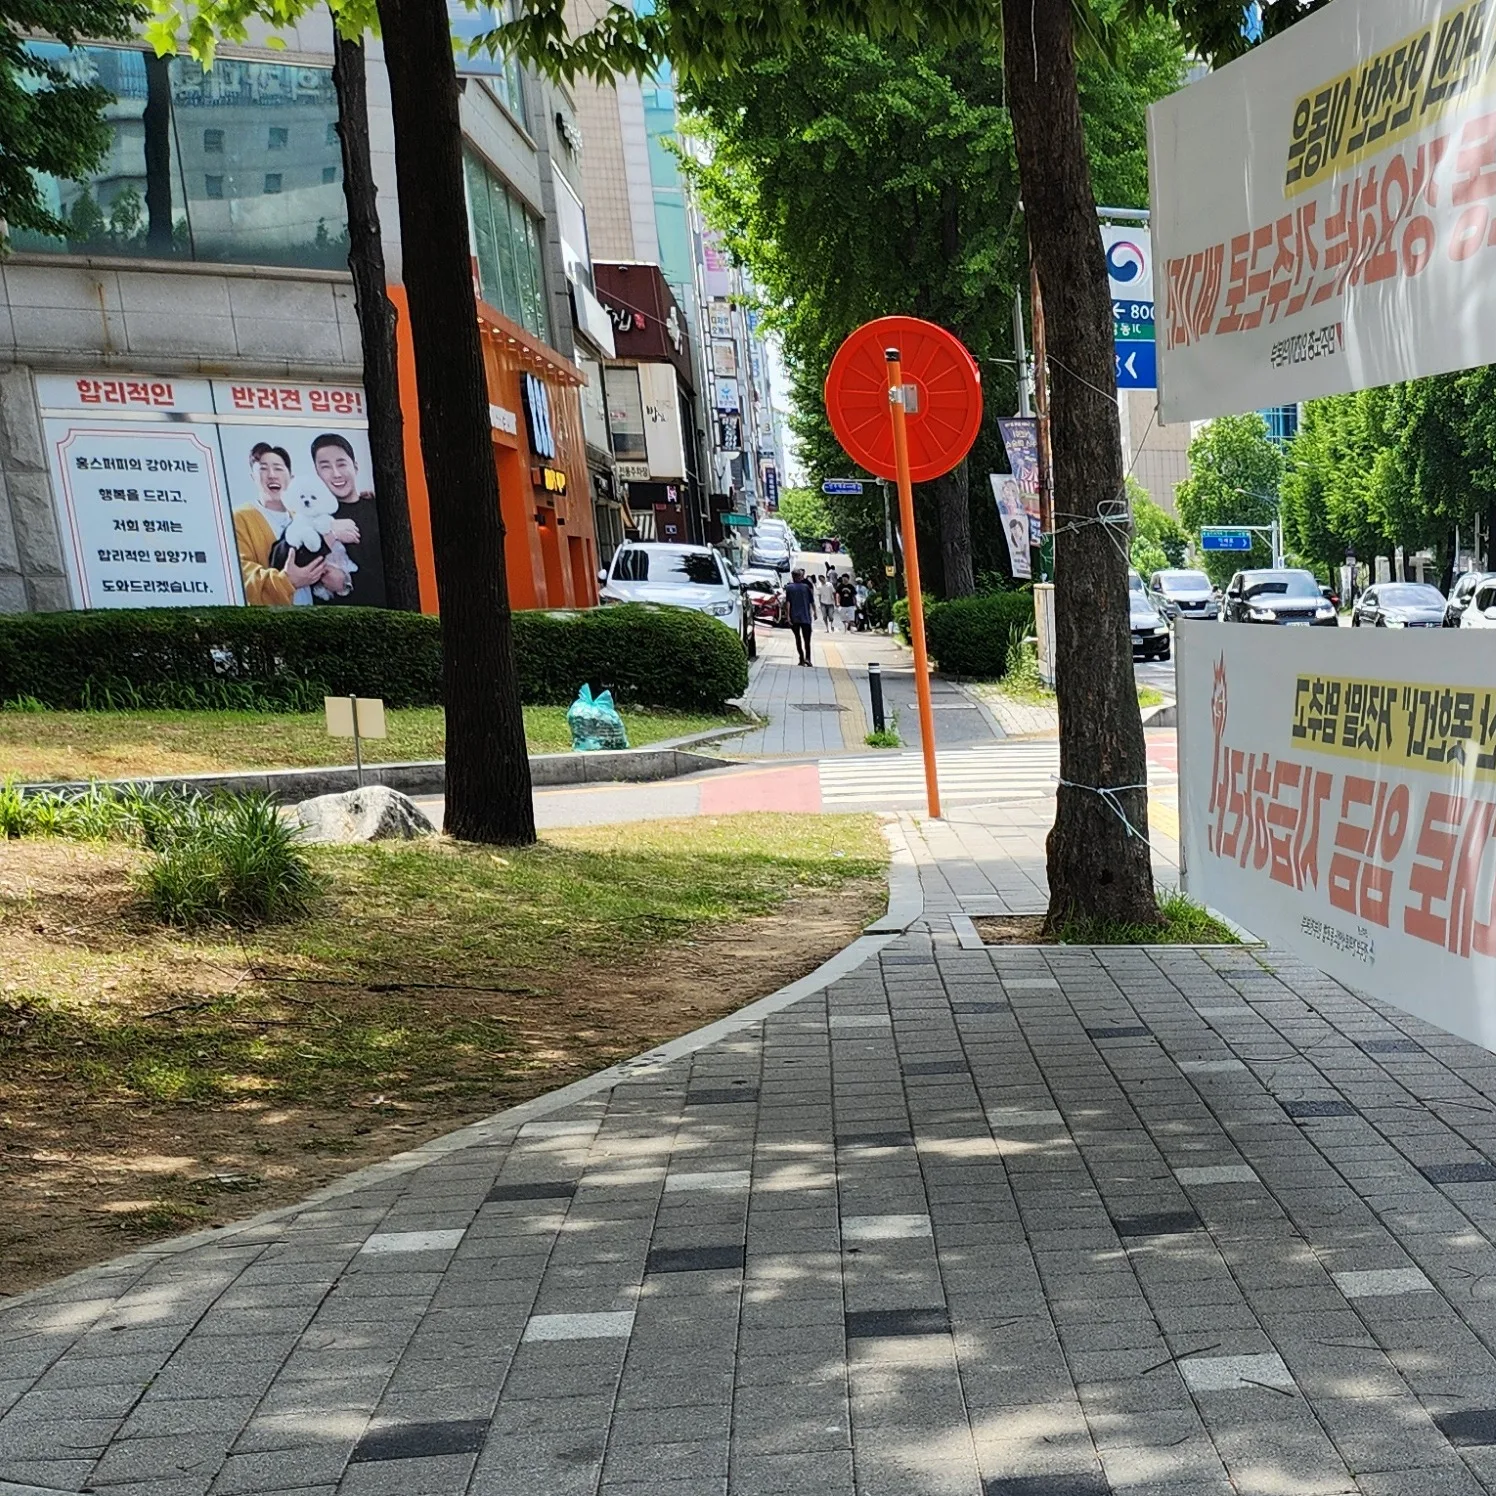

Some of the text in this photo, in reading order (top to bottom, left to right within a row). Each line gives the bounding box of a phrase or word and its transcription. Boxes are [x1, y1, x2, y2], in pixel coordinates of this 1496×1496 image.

[76, 379, 363, 414] 합리적인 반려견 입양!
[75, 456, 200, 474] 홍스퍼피의 강아지는
[98, 487, 141, 503] 행복을
[112, 518, 183, 533] 저희 형제는
[97, 548, 207, 564] 합리적인 입양가를
[102, 578, 214, 595] 도와드리겠습니다.
